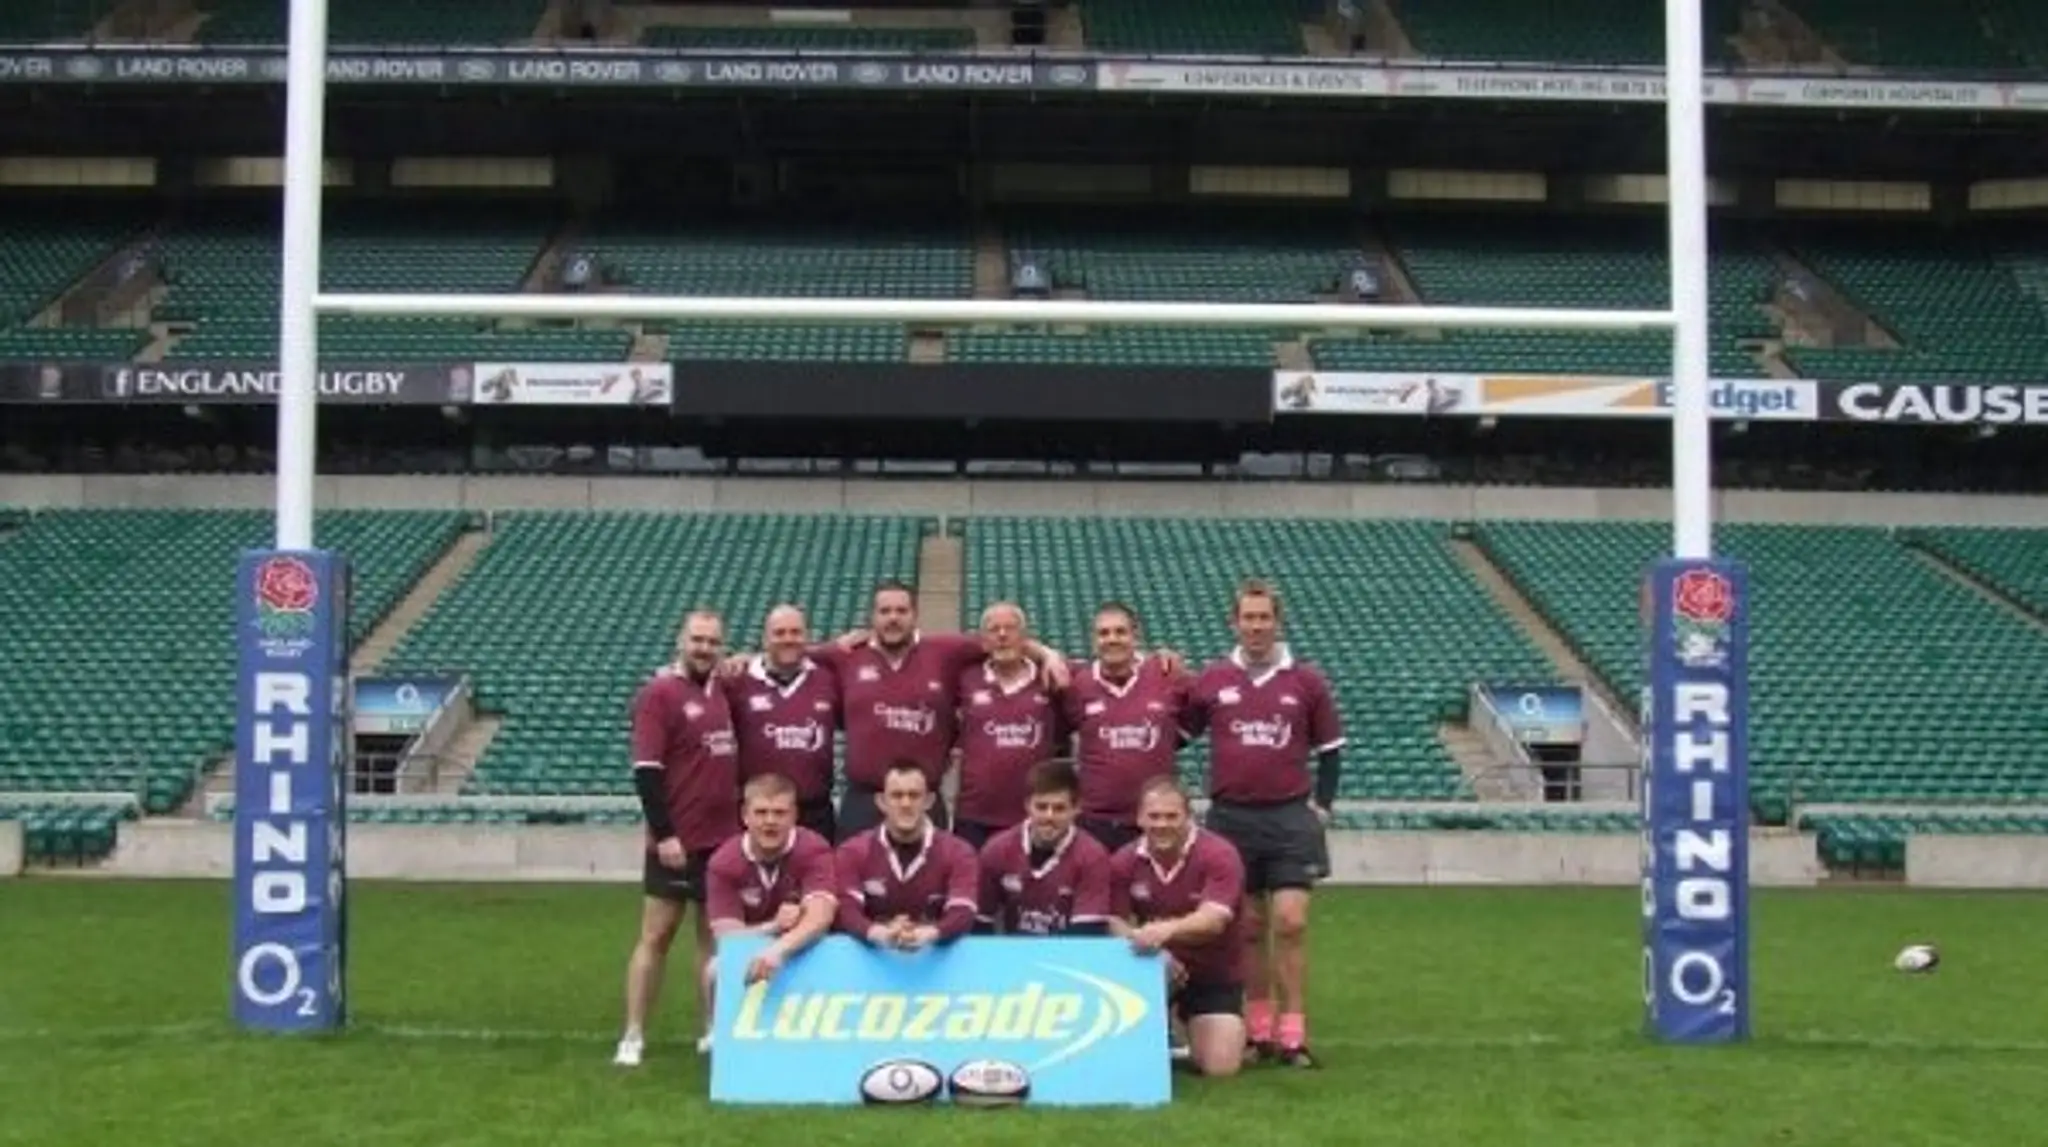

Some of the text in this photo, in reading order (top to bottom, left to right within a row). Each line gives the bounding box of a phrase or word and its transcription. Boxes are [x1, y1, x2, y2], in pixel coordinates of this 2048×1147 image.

[0, 57, 52, 78] OVER
[116, 57, 248, 77] LAND ROVER
[327, 59, 442, 79] AND ROVER
[508, 60, 640, 81] LAND ROVER
[705, 62, 838, 81] LAND ROVER
[903, 63, 1033, 83] LAND ROVER
[318, 371, 404, 394] UGBY
[1656, 381, 1798, 413] Bdget
[1837, 382, 2048, 423] CAUSE
[253, 672, 312, 914] RHINO
[1673, 682, 1732, 920] RHINO
[731, 979, 1084, 1041] Lucozade
